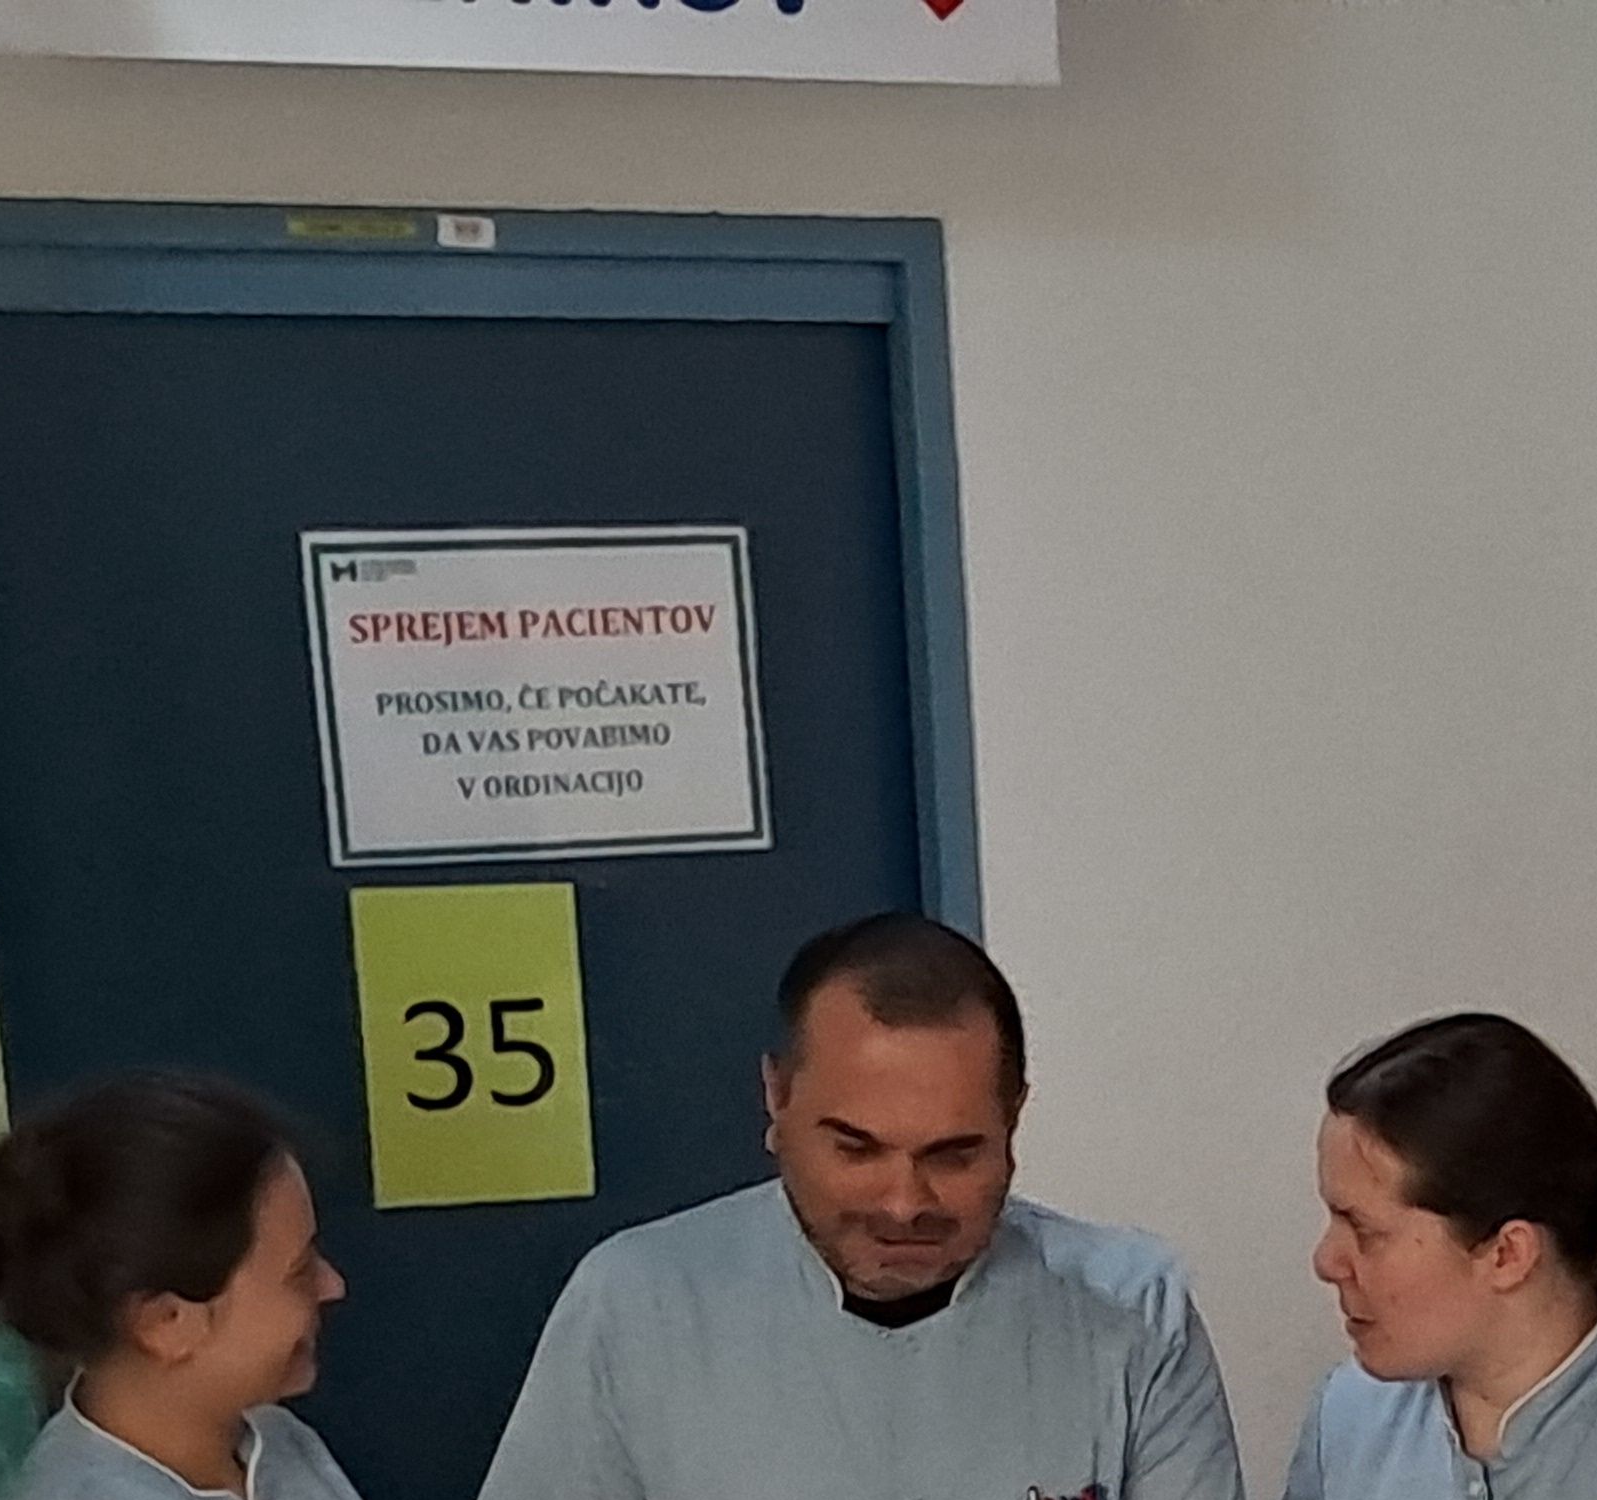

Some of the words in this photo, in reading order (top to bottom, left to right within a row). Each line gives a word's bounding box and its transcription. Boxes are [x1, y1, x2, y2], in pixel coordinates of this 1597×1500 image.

[349, 609, 509, 646] SPREJEM
[520, 605, 717, 640] PACIENTOV
[376, 689, 512, 717] PROSIMO,
[518, 684, 551, 711] ČE
[558, 680, 708, 710] POČAKATE,
[422, 731, 462, 756] DA
[468, 728, 521, 752] VAS
[527, 723, 671, 749] POVABIMO
[457, 775, 477, 801] V
[483, 768, 644, 798] ORDINACIJO
[404, 998, 556, 1111] 35
